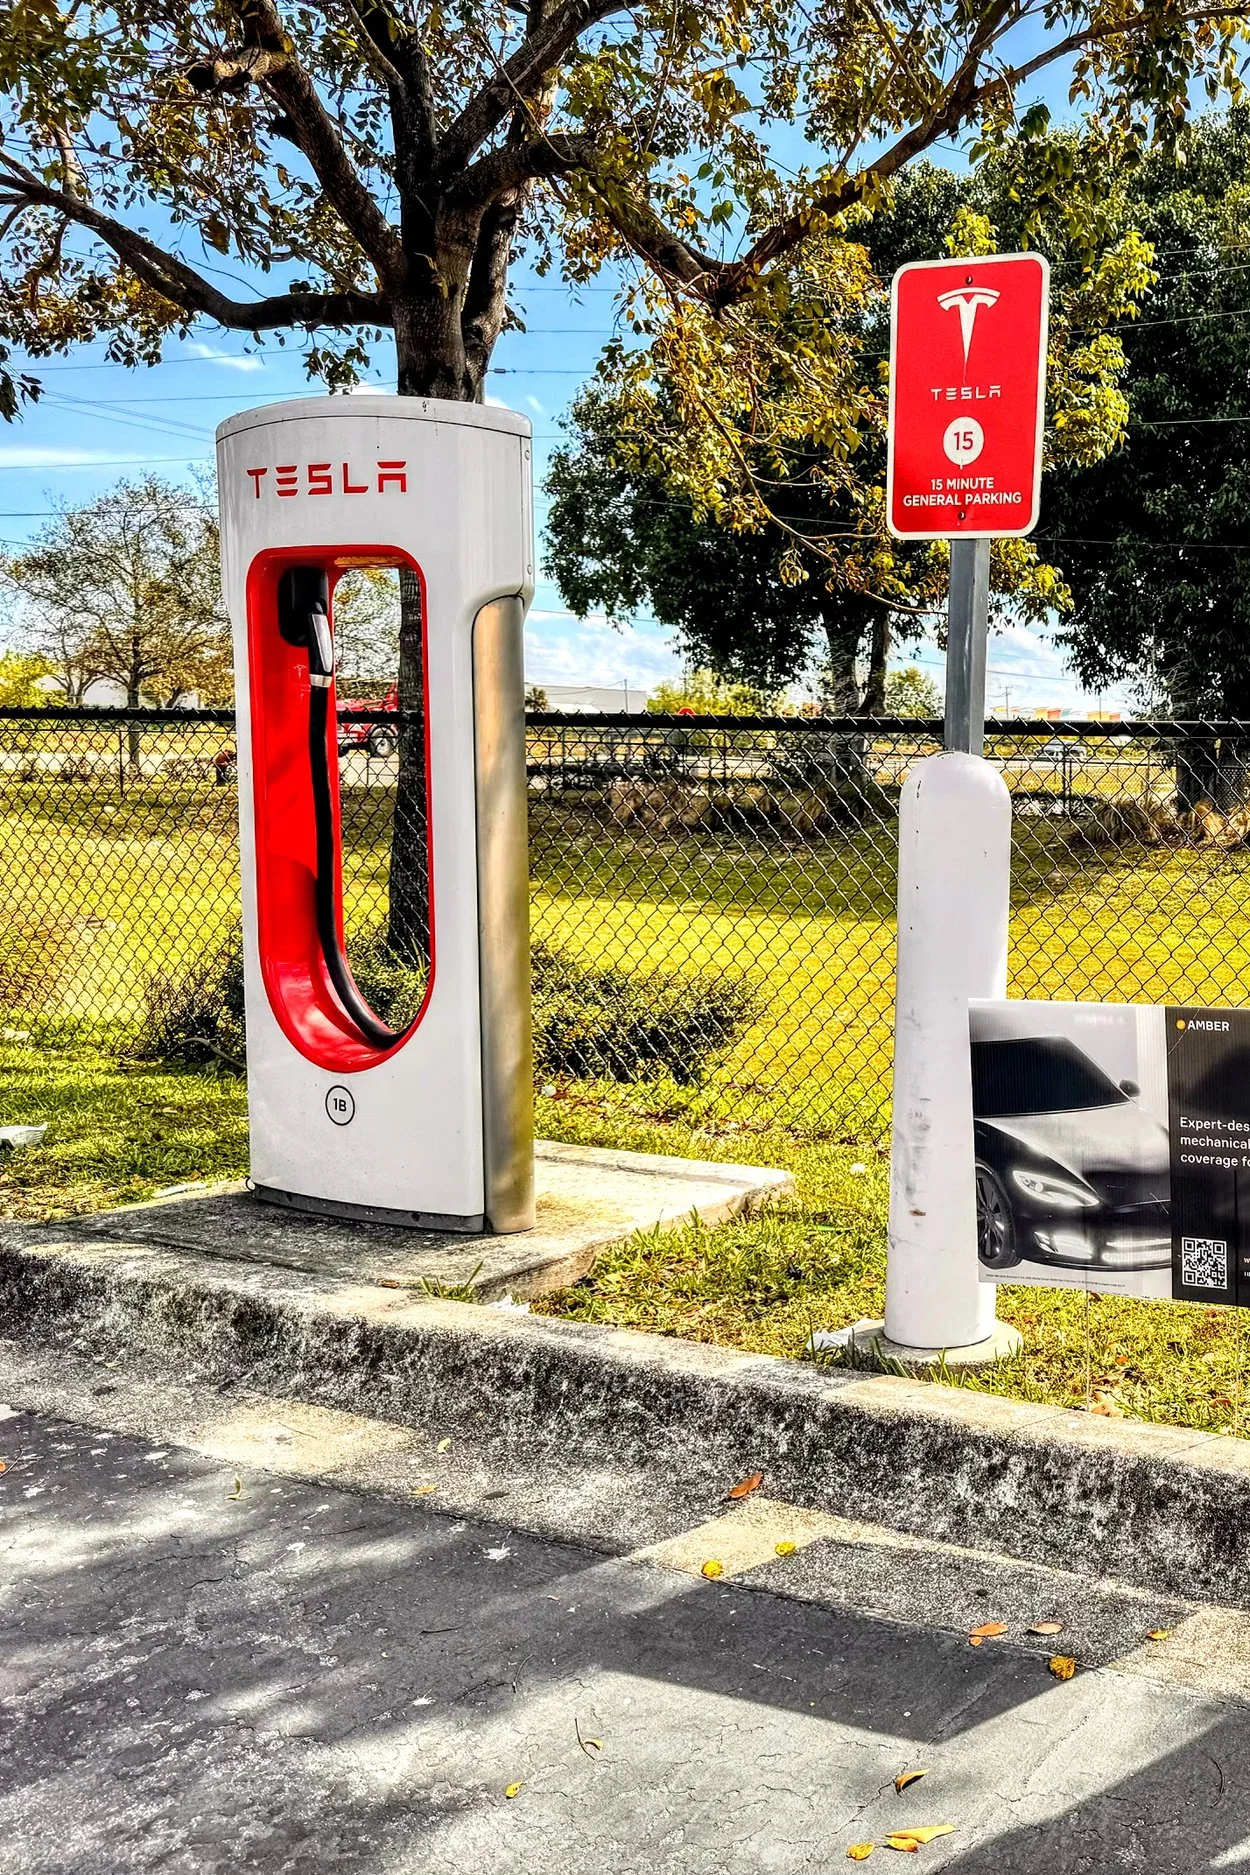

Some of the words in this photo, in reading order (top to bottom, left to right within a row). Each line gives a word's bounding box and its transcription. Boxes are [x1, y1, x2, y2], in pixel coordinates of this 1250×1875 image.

[930, 385, 1002, 401] TESLA
[953, 431, 974, 451] 15
[246, 461, 407, 499] TESLA
[931, 479, 943, 491] 15
[946, 477, 994, 490] MINUTE
[903, 494, 962, 507] GENERAL
[965, 491, 1022, 505] PARKING
[1187, 1020, 1230, 1032] AMBER
[333, 1097, 347, 1112] 1B
[1180, 1135, 1250, 1150] mechanical
[1180, 1153, 1239, 1168] coverage
